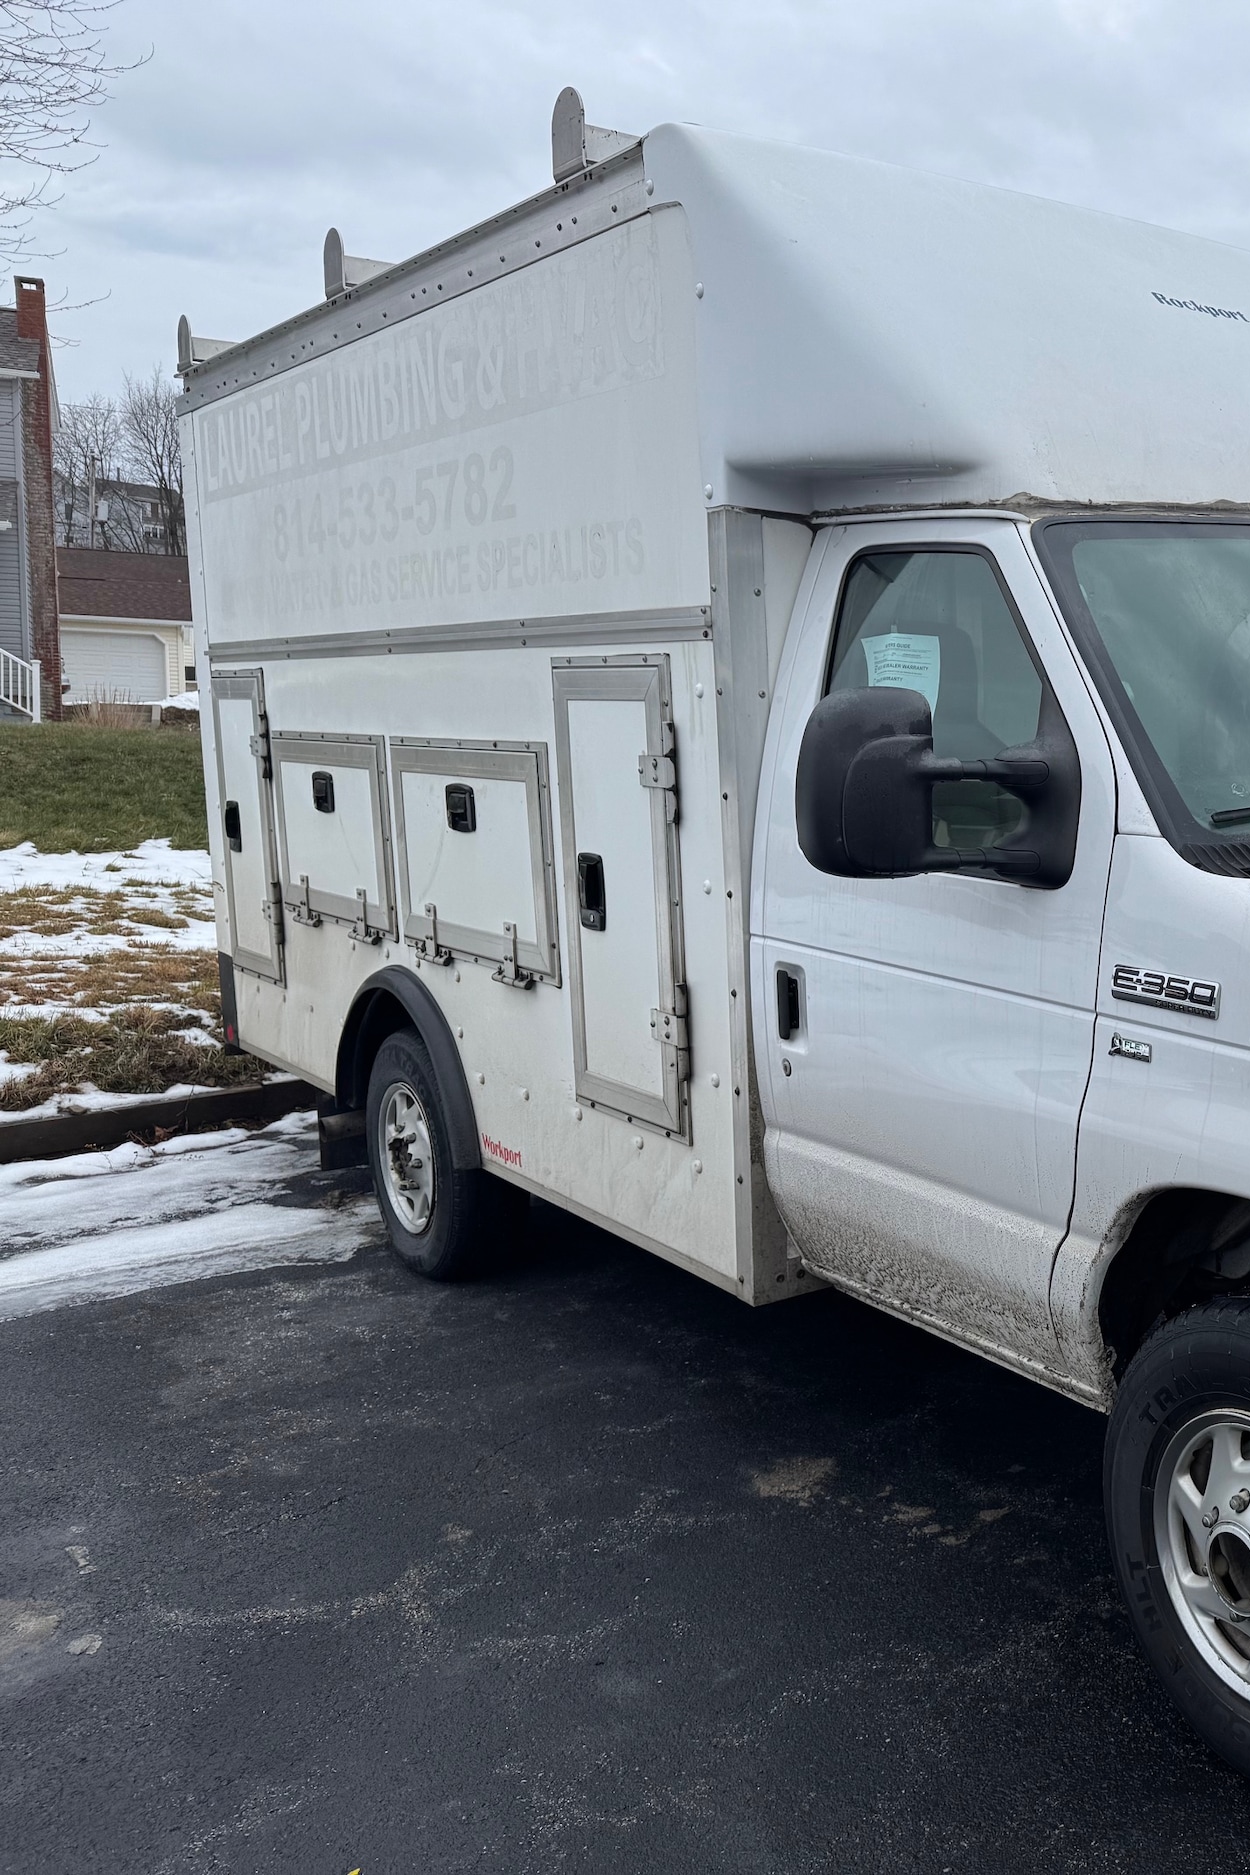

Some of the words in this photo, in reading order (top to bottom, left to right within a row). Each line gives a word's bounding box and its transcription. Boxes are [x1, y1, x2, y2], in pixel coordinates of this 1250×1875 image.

[1150, 291, 1250, 324] Rockport
[203, 391, 292, 492] LAUREL
[295, 320, 466, 465] PLUMBING
[476, 305, 506, 410] &
[273, 444, 517, 562] 814-533-5782
[347, 558, 382, 607] GAS
[387, 544, 471, 602] SERVICE
[477, 516, 646, 593] SPECIALISTS
[1113, 967, 1216, 1007] E-350
[481, 1132, 522, 1168] Workport
